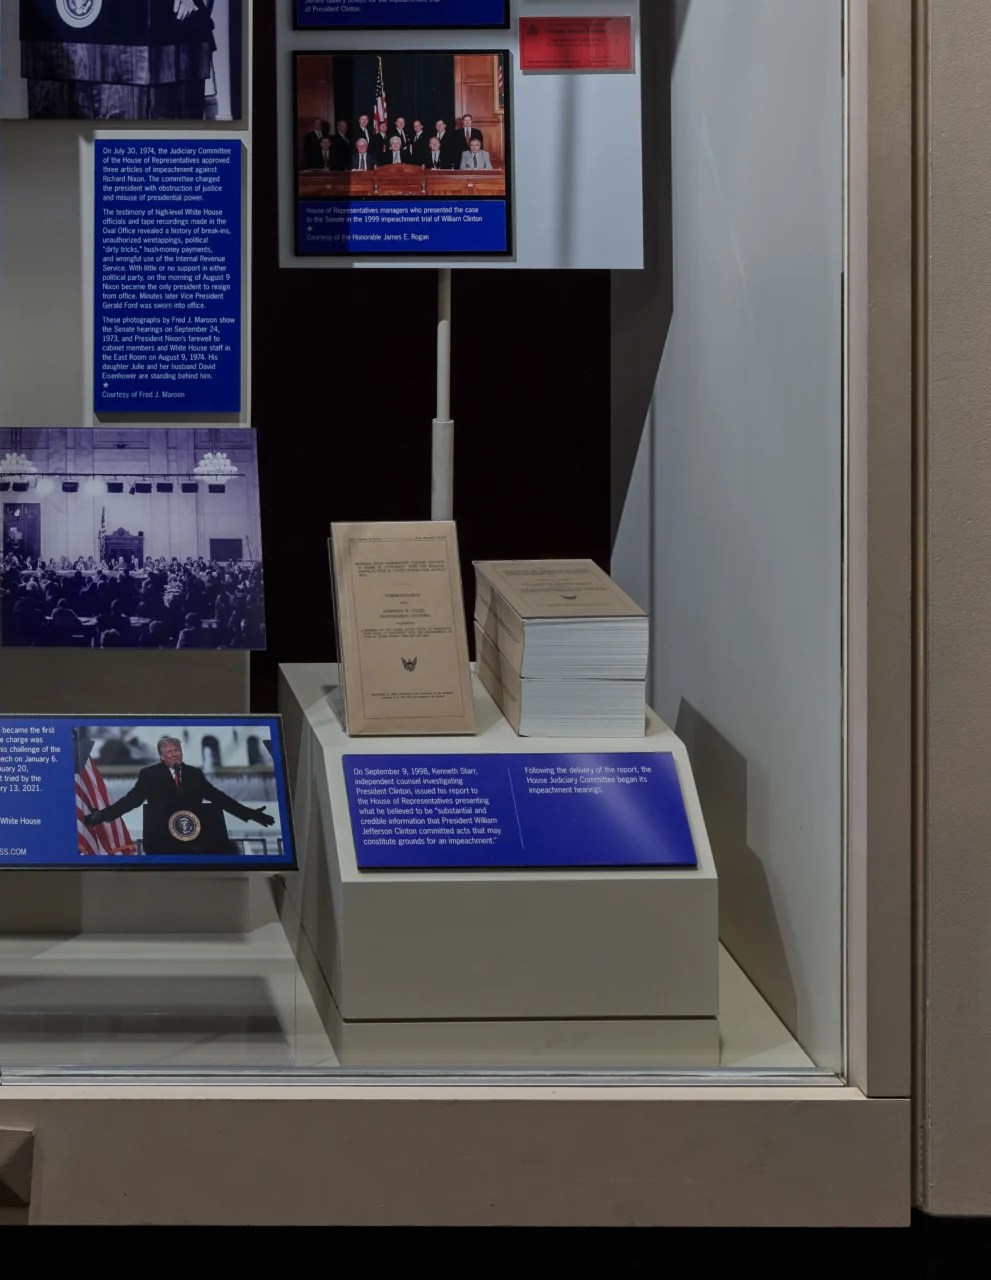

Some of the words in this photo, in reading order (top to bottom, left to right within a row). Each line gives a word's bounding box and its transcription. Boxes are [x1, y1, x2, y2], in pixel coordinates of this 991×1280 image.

[102, 147, 112, 155] On
[113, 147, 126, 156] July
[126, 147, 138, 156] 30,
[139, 147, 157, 156] 1974,
[157, 147, 169, 155] the
[169, 147, 197, 156] Judiciary
[197, 147, 232, 155] Committee
[101, 390, 130, 400] Courtesy
[130, 390, 138, 398] of
[138, 390, 154, 398] Fred
[154, 390, 161, 398] J.
[161, 390, 186, 398] Maroon
[353, 767, 364, 775] On
[364, 766, 401, 778] September
[401, 766, 409, 776] 9,
[411, 766, 431, 776] 1998,
[431, 766, 459, 775] Kenneth
[459, 766, 479, 776] Starr,
[526, 775, 548, 784] House
[549, 775, 578, 786] Judiciary
[579, 774, 616, 783] Committee
[616, 774, 638, 785] began
[638, 774, 648, 783] its
[9, 785, 21, 793] 13,
